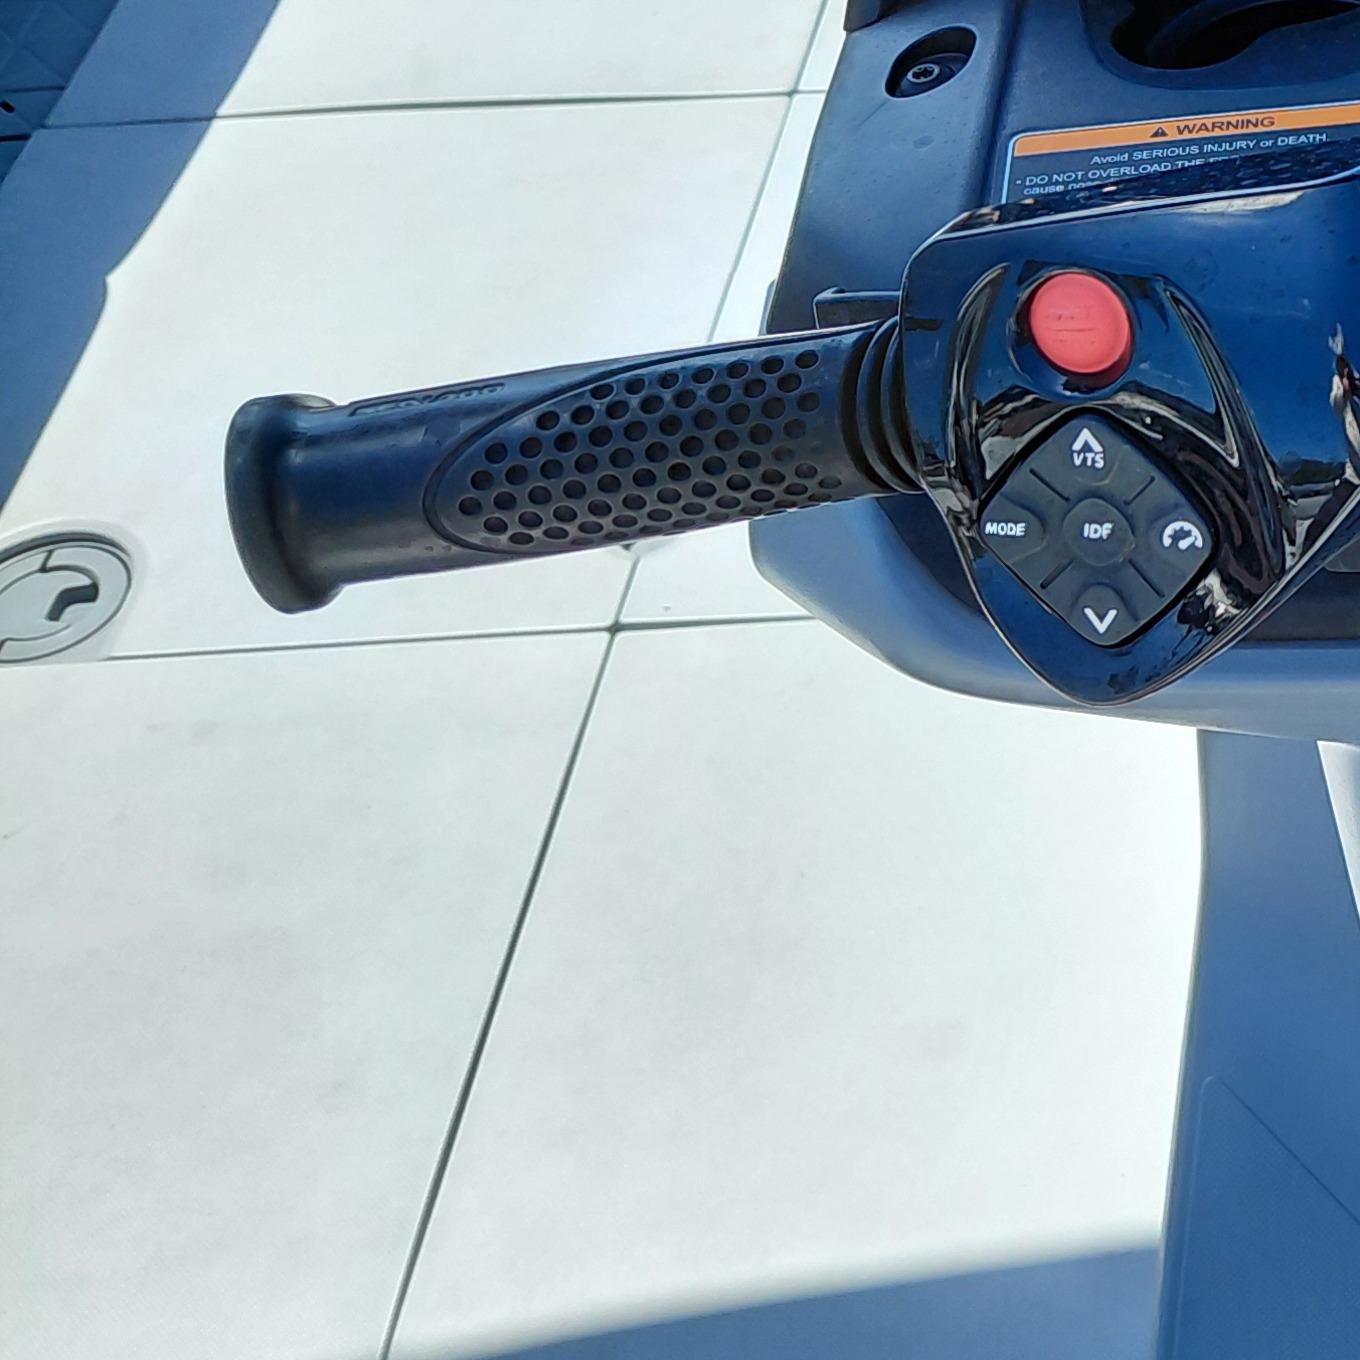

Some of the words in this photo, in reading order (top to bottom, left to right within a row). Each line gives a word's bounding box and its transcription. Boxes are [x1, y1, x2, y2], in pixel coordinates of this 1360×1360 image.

[1176, 116, 1275, 136] WARNING
[1090, 152, 1129, 165] Avoid
[1131, 145, 1199, 161] SERIOUS
[1203, 140, 1257, 154] INJURY
[1259, 139, 1275, 148] or
[1277, 133, 1329, 146] DEATH.
[1025, 175, 1049, 186] DO
[1052, 171, 1086, 183] NOT
[1088, 162, 1172, 179] OVERLOAD
[1023, 185, 1065, 196] cause
[1072, 451, 1105, 468] VTS
[984, 521, 1027, 537] MODE
[1083, 522, 1113, 540] IDF
